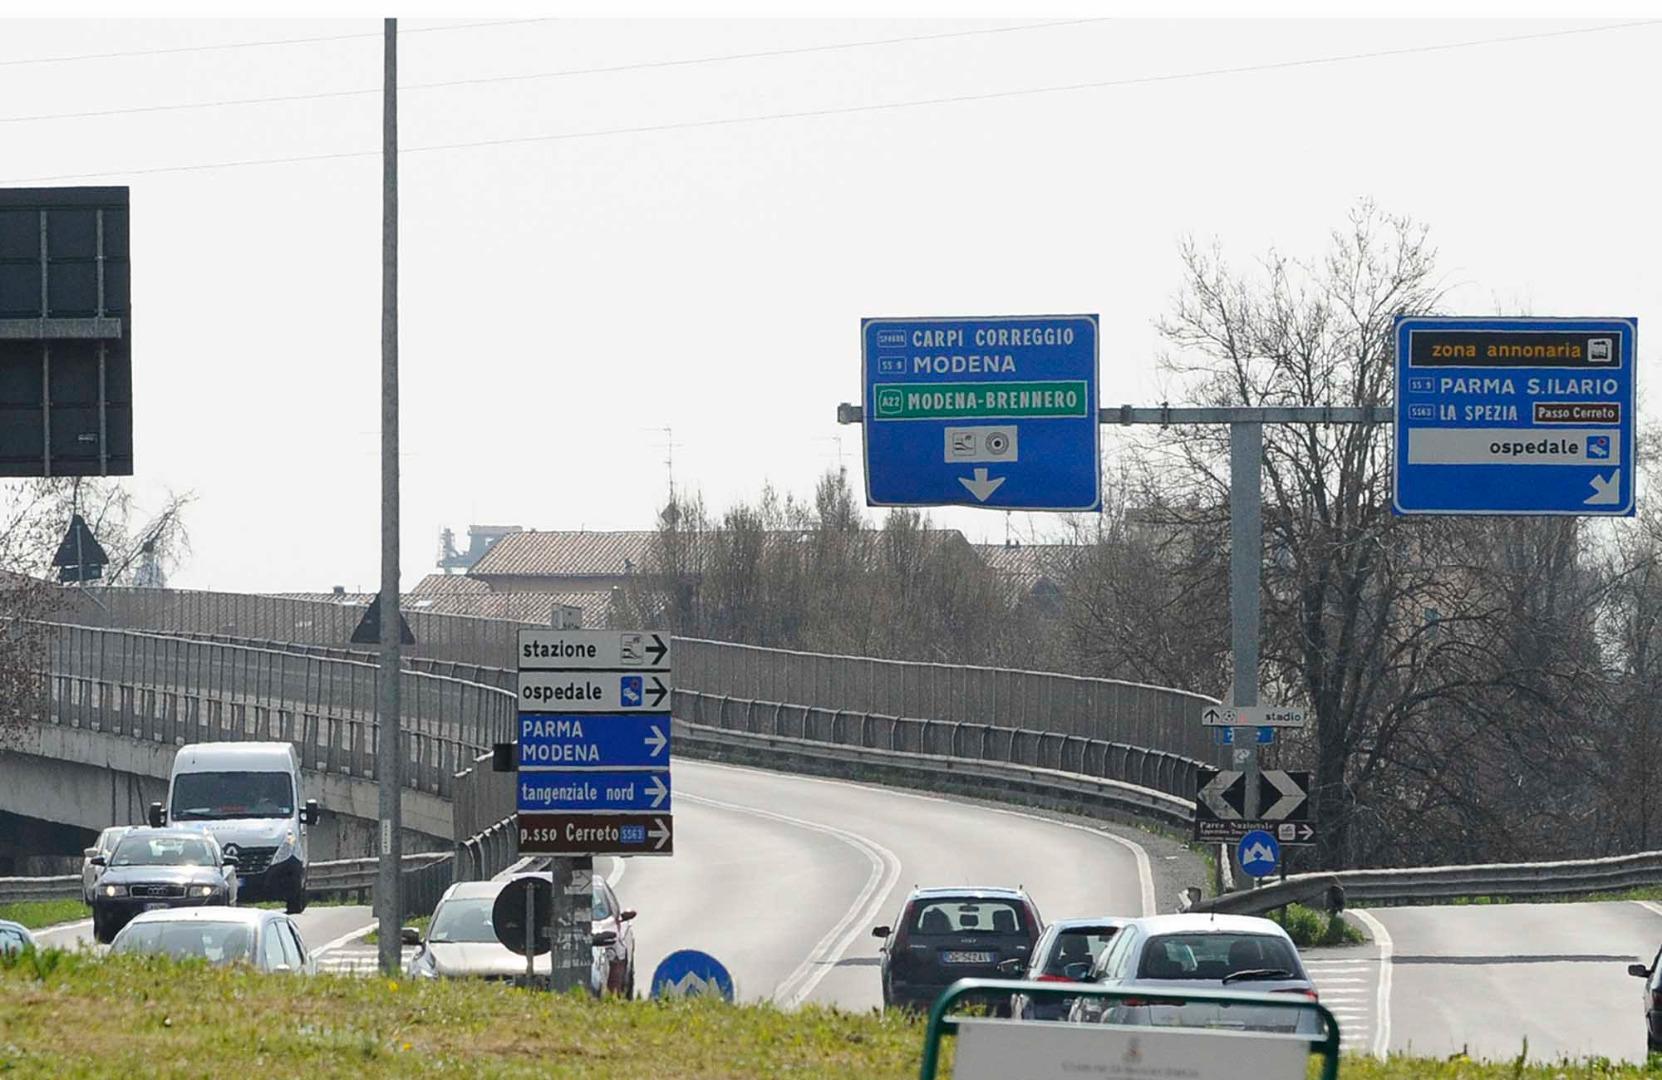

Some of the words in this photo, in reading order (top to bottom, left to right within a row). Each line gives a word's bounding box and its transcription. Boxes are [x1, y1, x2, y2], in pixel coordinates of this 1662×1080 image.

[912, 329, 963, 348] CARPI
[975, 327, 1074, 346] CORREGGIO
[1431, 343, 1476, 358] zona
[1486, 341, 1582, 359] annonaria
[913, 355, 1016, 374] MODENA
[1440, 377, 1515, 394] PARMA
[1526, 377, 1618, 395] S.ILARIO
[881, 396, 900, 407] A22
[908, 390, 1077, 411] MODENA-BRENNERO
[1440, 404, 1456, 421] LA
[1464, 404, 1518, 421] SPEZIA
[1537, 406, 1570, 418] Passo
[1572, 406, 1615, 418] Cerreto
[1489, 439, 1579, 457] ospedale
[522, 639, 597, 658] stazione
[522, 682, 602, 703] ospedale
[1265, 711, 1302, 721] stadio
[522, 720, 584, 738] PARMA
[522, 744, 600, 762] MODENA
[521, 782, 598, 805] tangenziale
[606, 782, 635, 801] nord
[520, 827, 558, 844] p.sso
[565, 824, 620, 842] Cerreto
[621, 827, 643, 841] SS63
